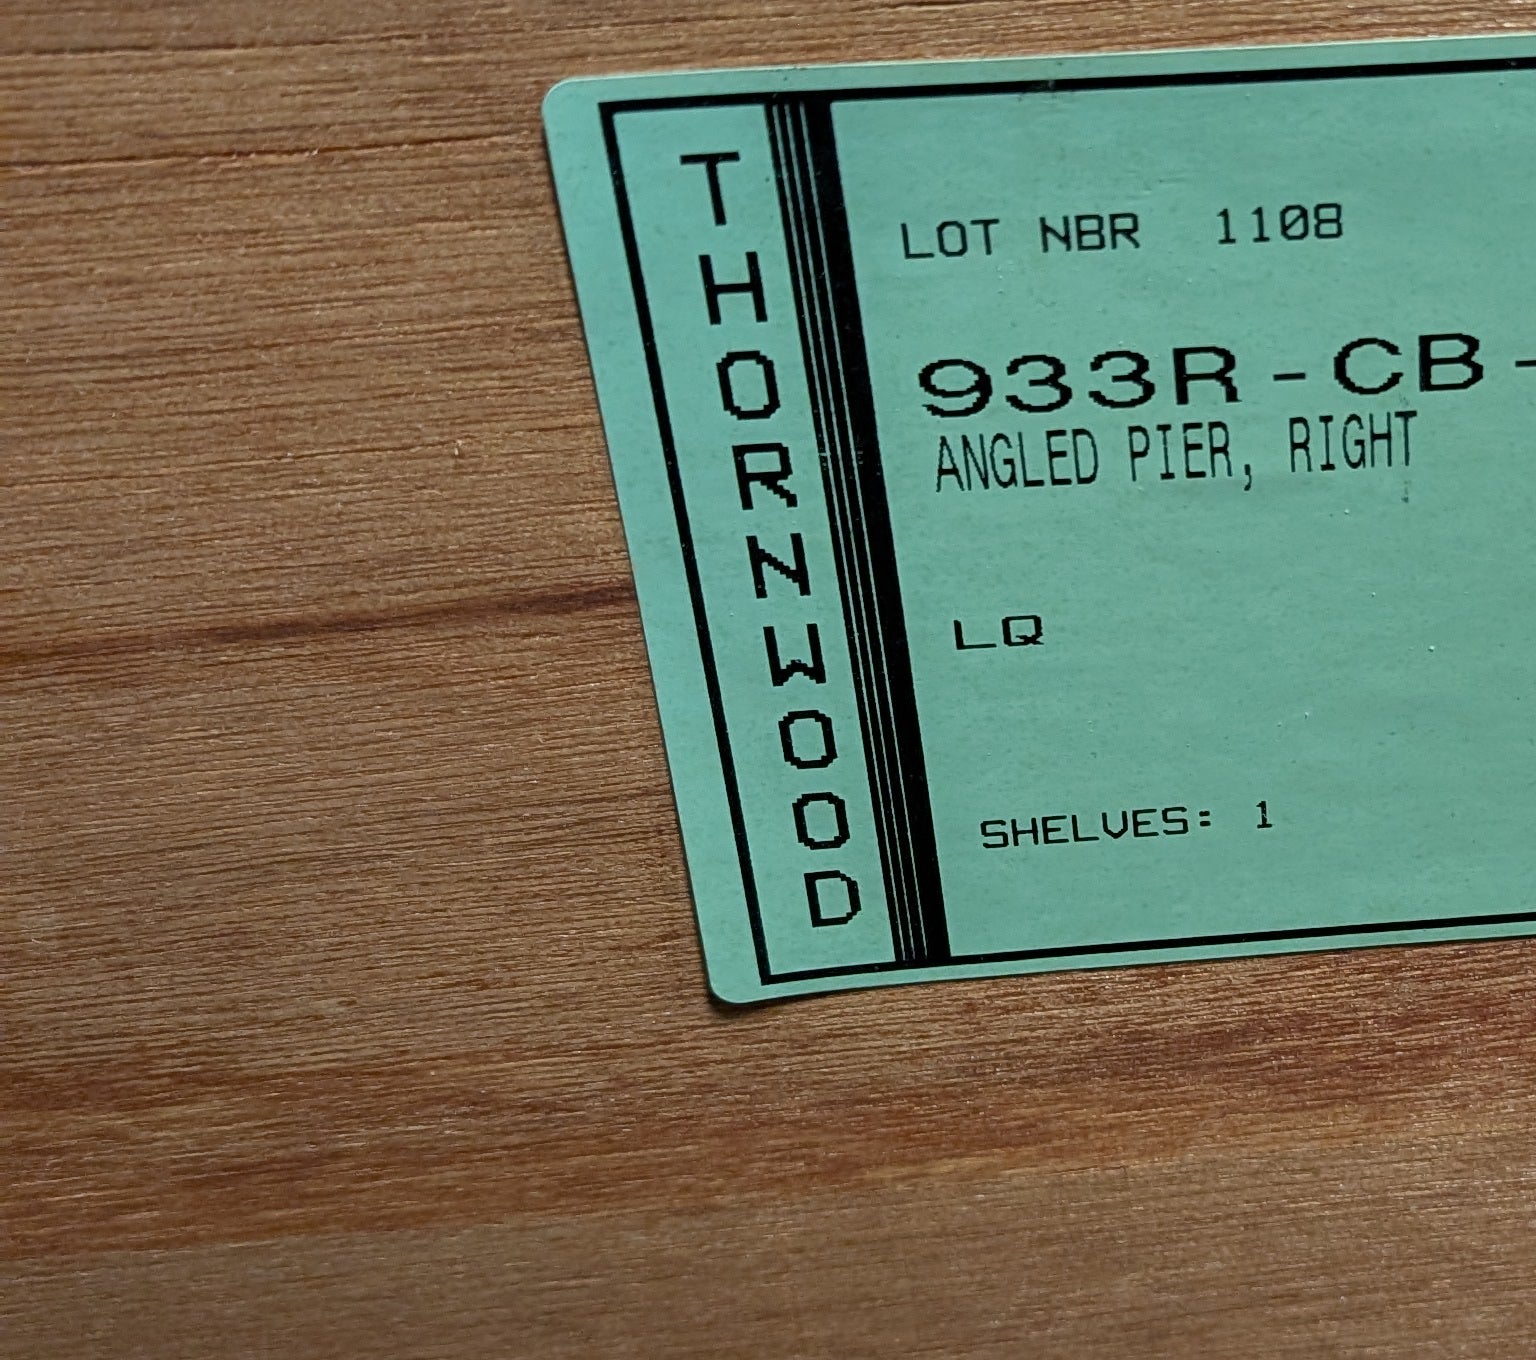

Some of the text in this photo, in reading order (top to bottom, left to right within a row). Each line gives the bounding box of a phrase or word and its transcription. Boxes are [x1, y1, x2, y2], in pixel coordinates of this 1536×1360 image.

[900, 203, 1344, 260] LOT NBR 1108
[935, 409, 1418, 493] ANGLED PIER, RIGHT
[679, 150, 863, 928] THORNWOOD
[953, 614, 1045, 651] LQ
[979, 800, 1275, 850] SHELVES: 1
